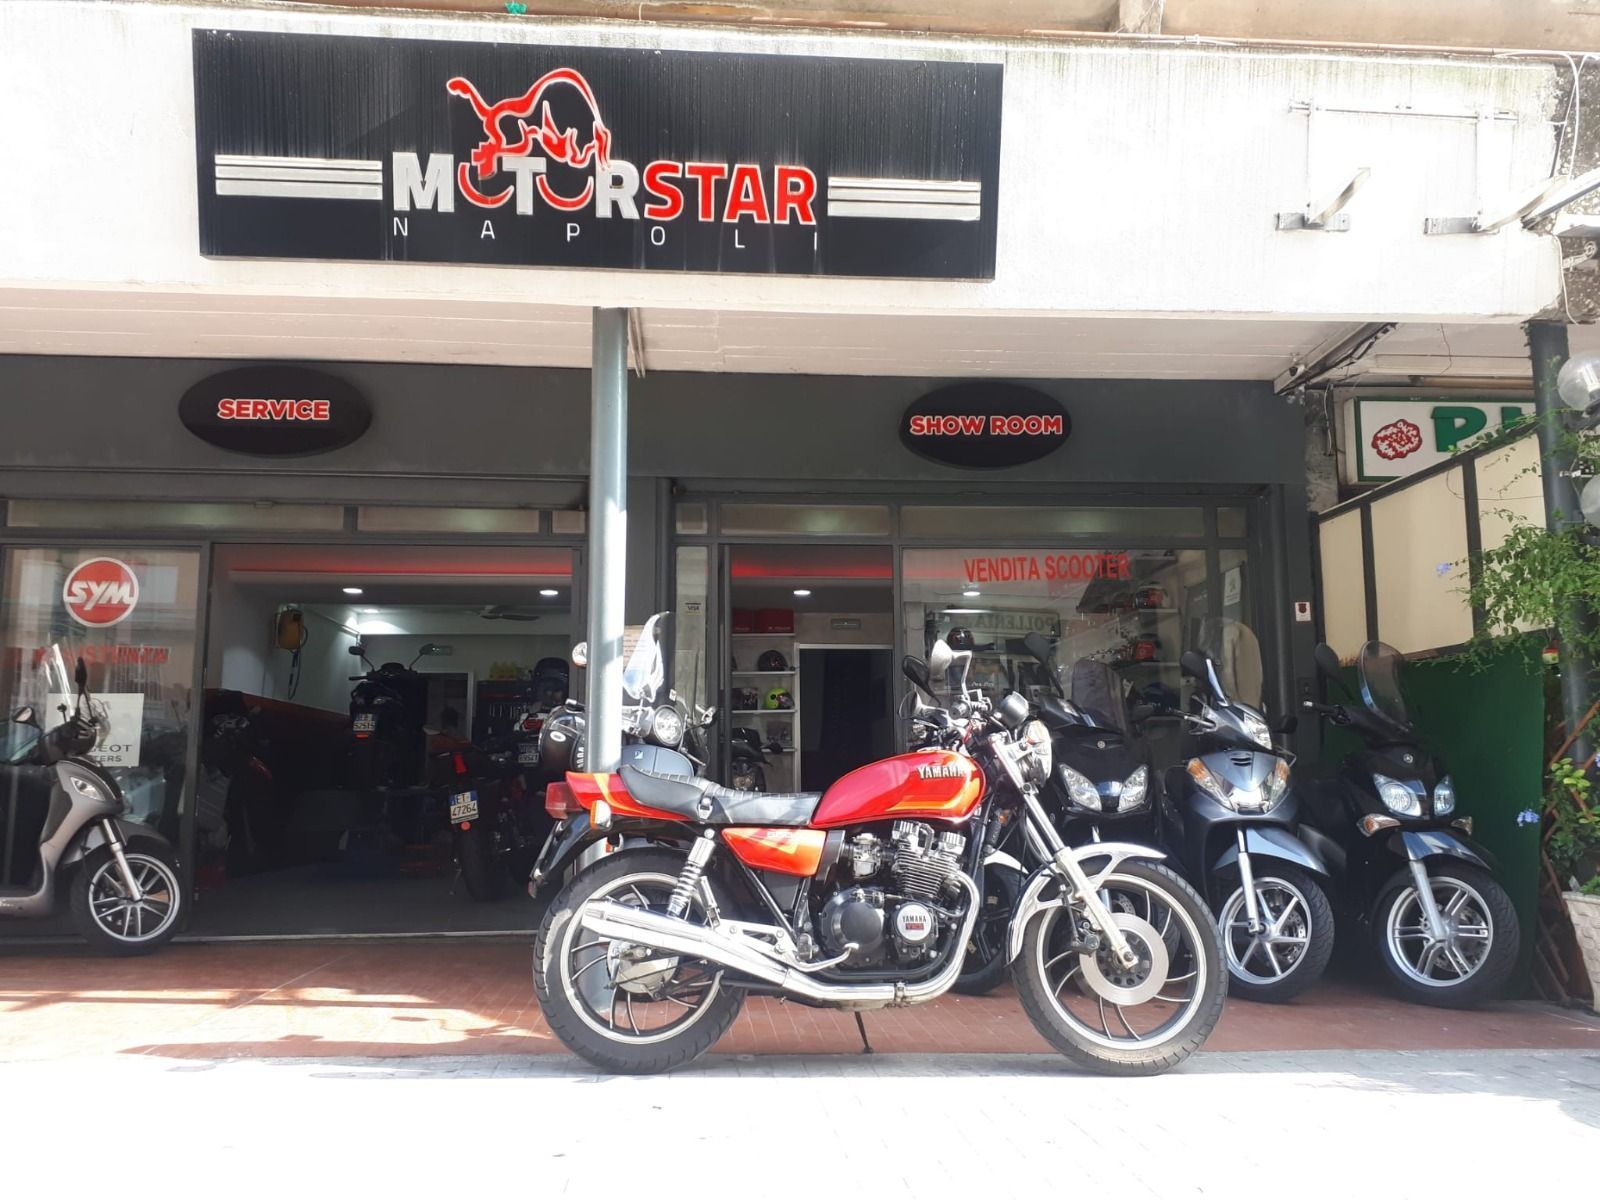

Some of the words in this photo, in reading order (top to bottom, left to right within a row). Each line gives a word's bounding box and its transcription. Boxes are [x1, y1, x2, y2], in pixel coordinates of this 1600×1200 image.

[393, 217, 818, 250] NAPOLI
[217, 398, 330, 420] SERVICE
[910, 415, 985, 435] SHOW
[990, 415, 1063, 436] ROOM
[964, 556, 1040, 583] VENDITA
[1044, 553, 1131, 581] SCOOTER
[69, 580, 135, 611] SYM
[917, 765, 964, 779] YAMAHA
[452, 802, 477, 816] 47264
[902, 914, 927, 922] YAMAHA
